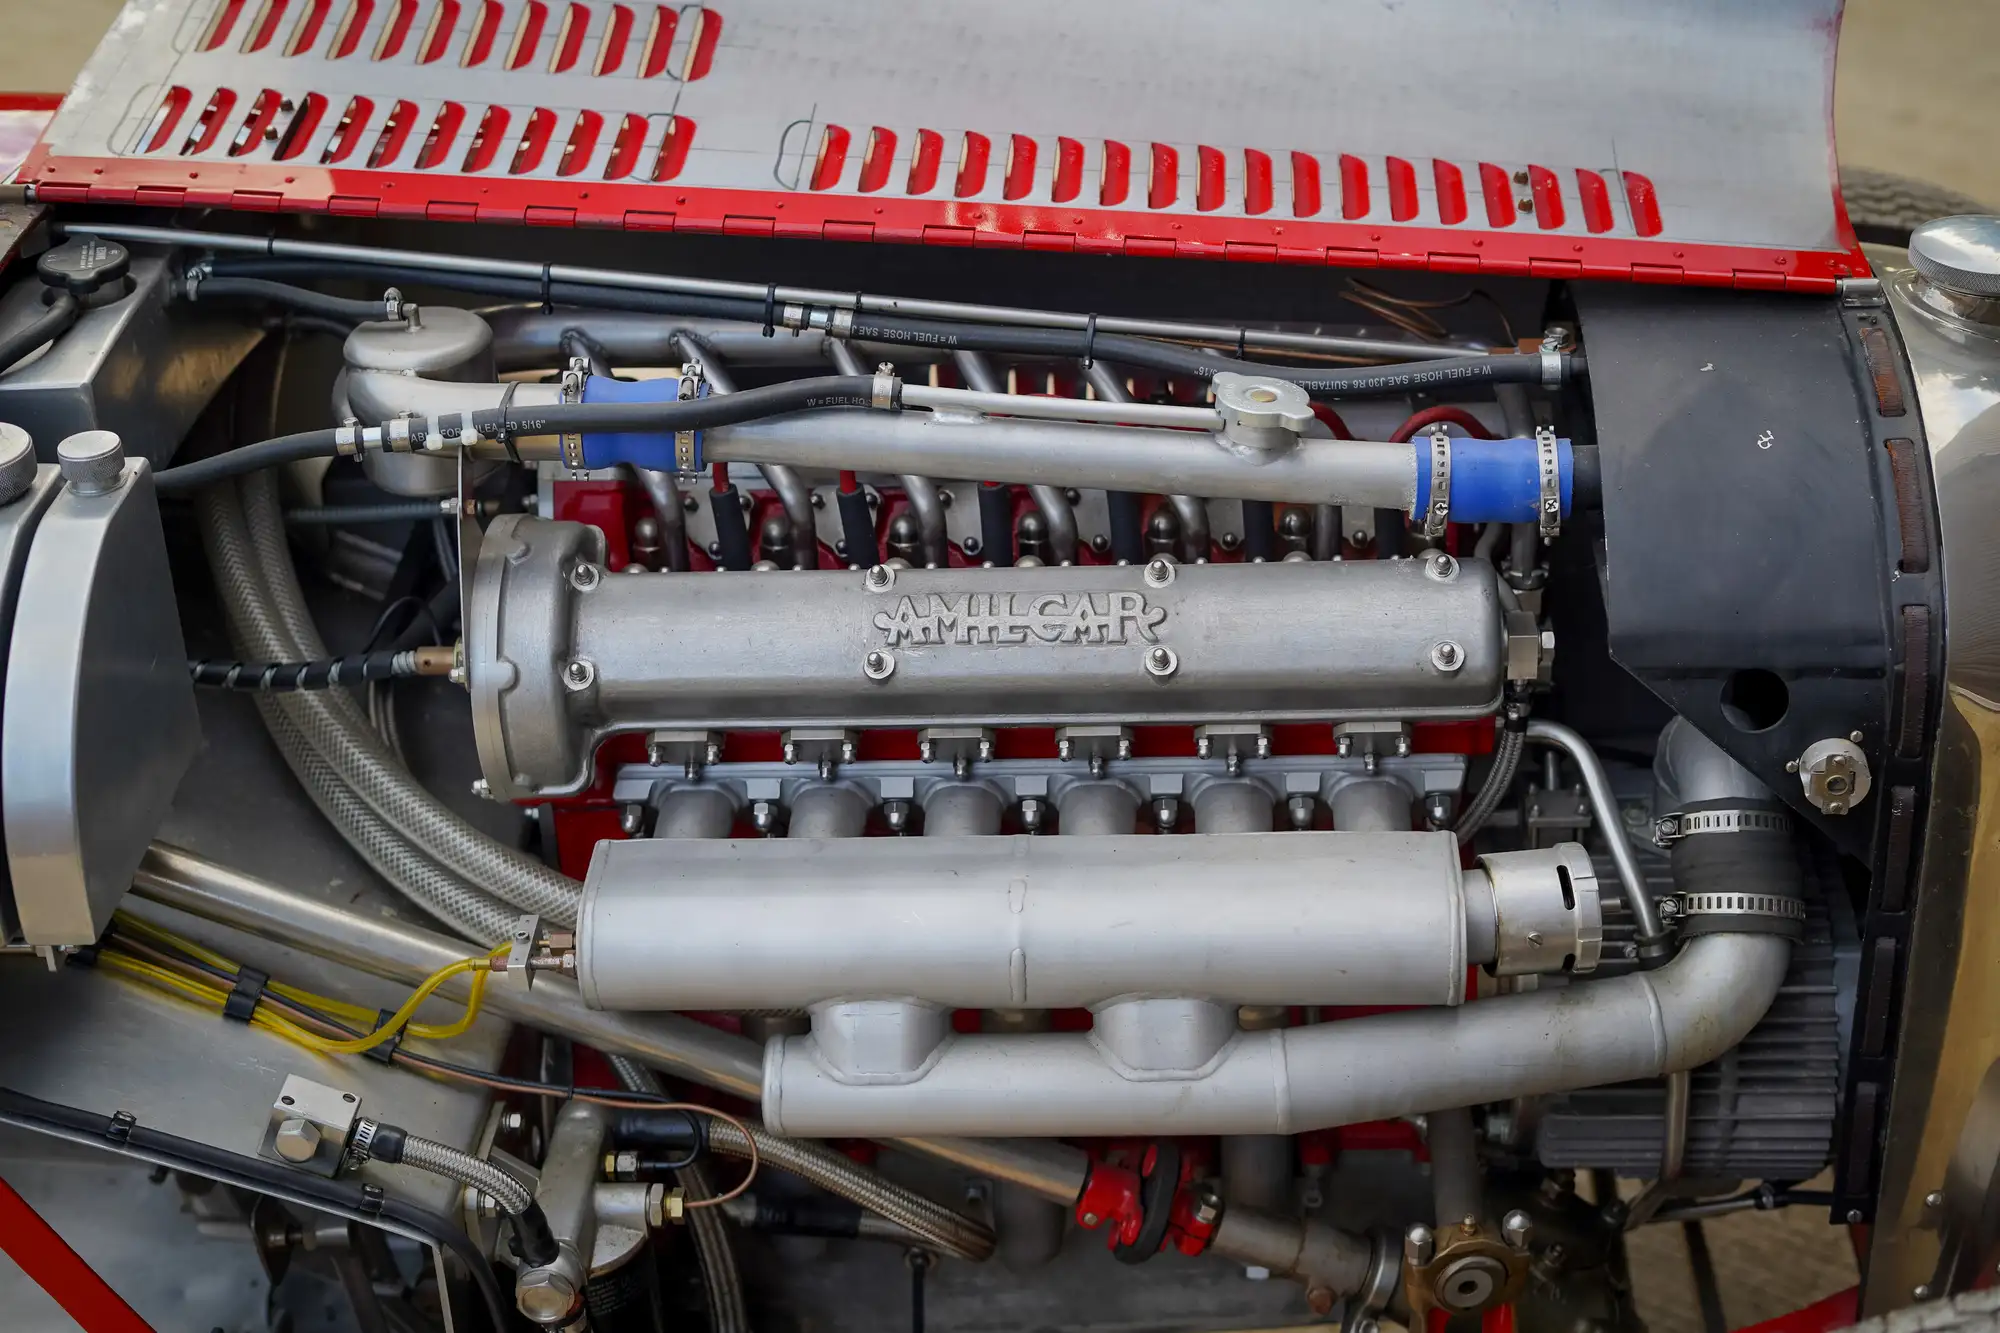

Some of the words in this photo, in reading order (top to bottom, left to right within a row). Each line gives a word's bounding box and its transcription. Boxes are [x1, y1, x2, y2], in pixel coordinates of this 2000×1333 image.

[858, 325, 879, 337] SAE
[883, 328, 911, 341] HOSE
[913, 331, 938, 343] FUEL
[1413, 370, 1443, 383] HOSE
[1444, 366, 1472, 379] FUEL
[1298, 380, 1348, 390] SUITABLE
[1353, 379, 1366, 389] R6
[1368, 377, 1386, 387] J30
[1387, 374, 1409, 386] SAE
[825, 396, 849, 405] FUEL
[522, 419, 546, 430] 5/16"
[873, 591, 1167, 646] AMILCAR
